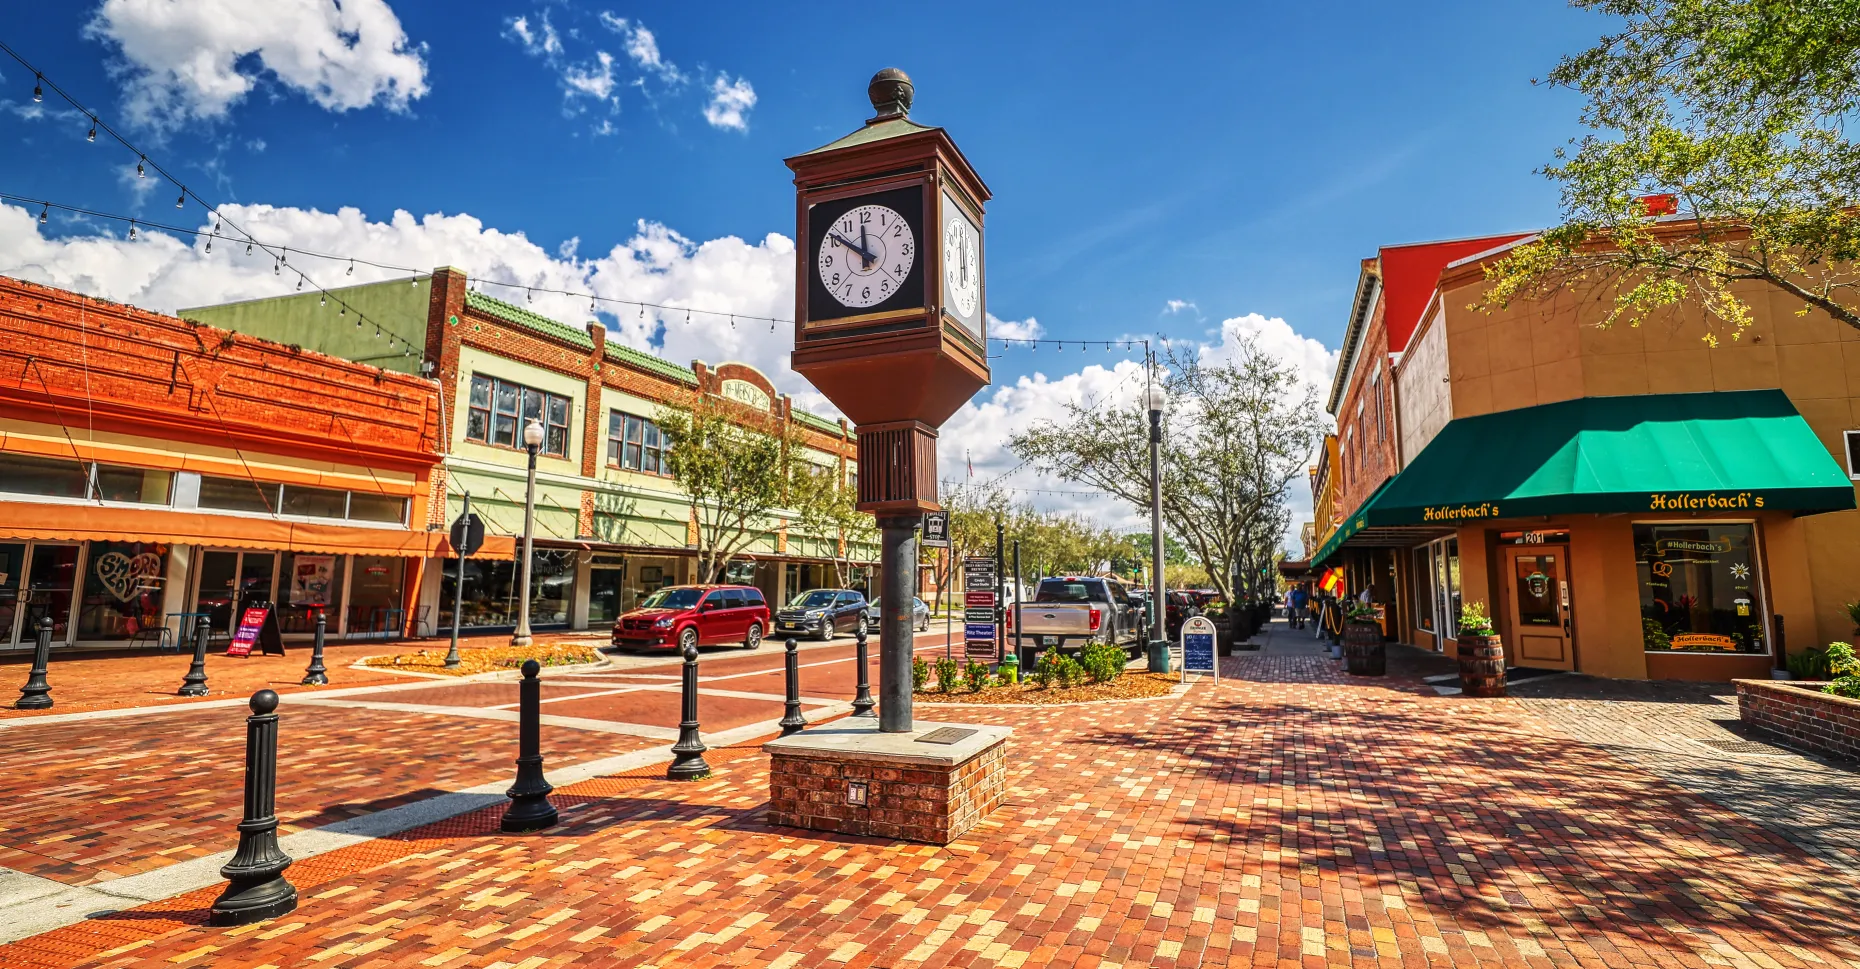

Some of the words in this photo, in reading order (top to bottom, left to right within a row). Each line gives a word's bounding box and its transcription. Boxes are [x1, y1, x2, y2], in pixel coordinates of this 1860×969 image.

[859, 211, 871, 224] 12
[843, 220, 853, 233] 11
[894, 225, 902, 237] 2
[829, 235, 842, 248] 10
[902, 243, 909, 255] 3
[825, 255, 833, 267] 9
[894, 264, 902, 276] 4
[832, 273, 840, 285] 8
[845, 284, 853, 296] 7
[881, 279, 889, 292] 5
[862, 287, 870, 299] 6
[1650, 492, 1765, 510] Hollerbach's
[1424, 502, 1499, 521] Hollerbach's
[1526, 533, 1543, 543] 201
[1667, 541, 1722, 551] #Hollerbach's
